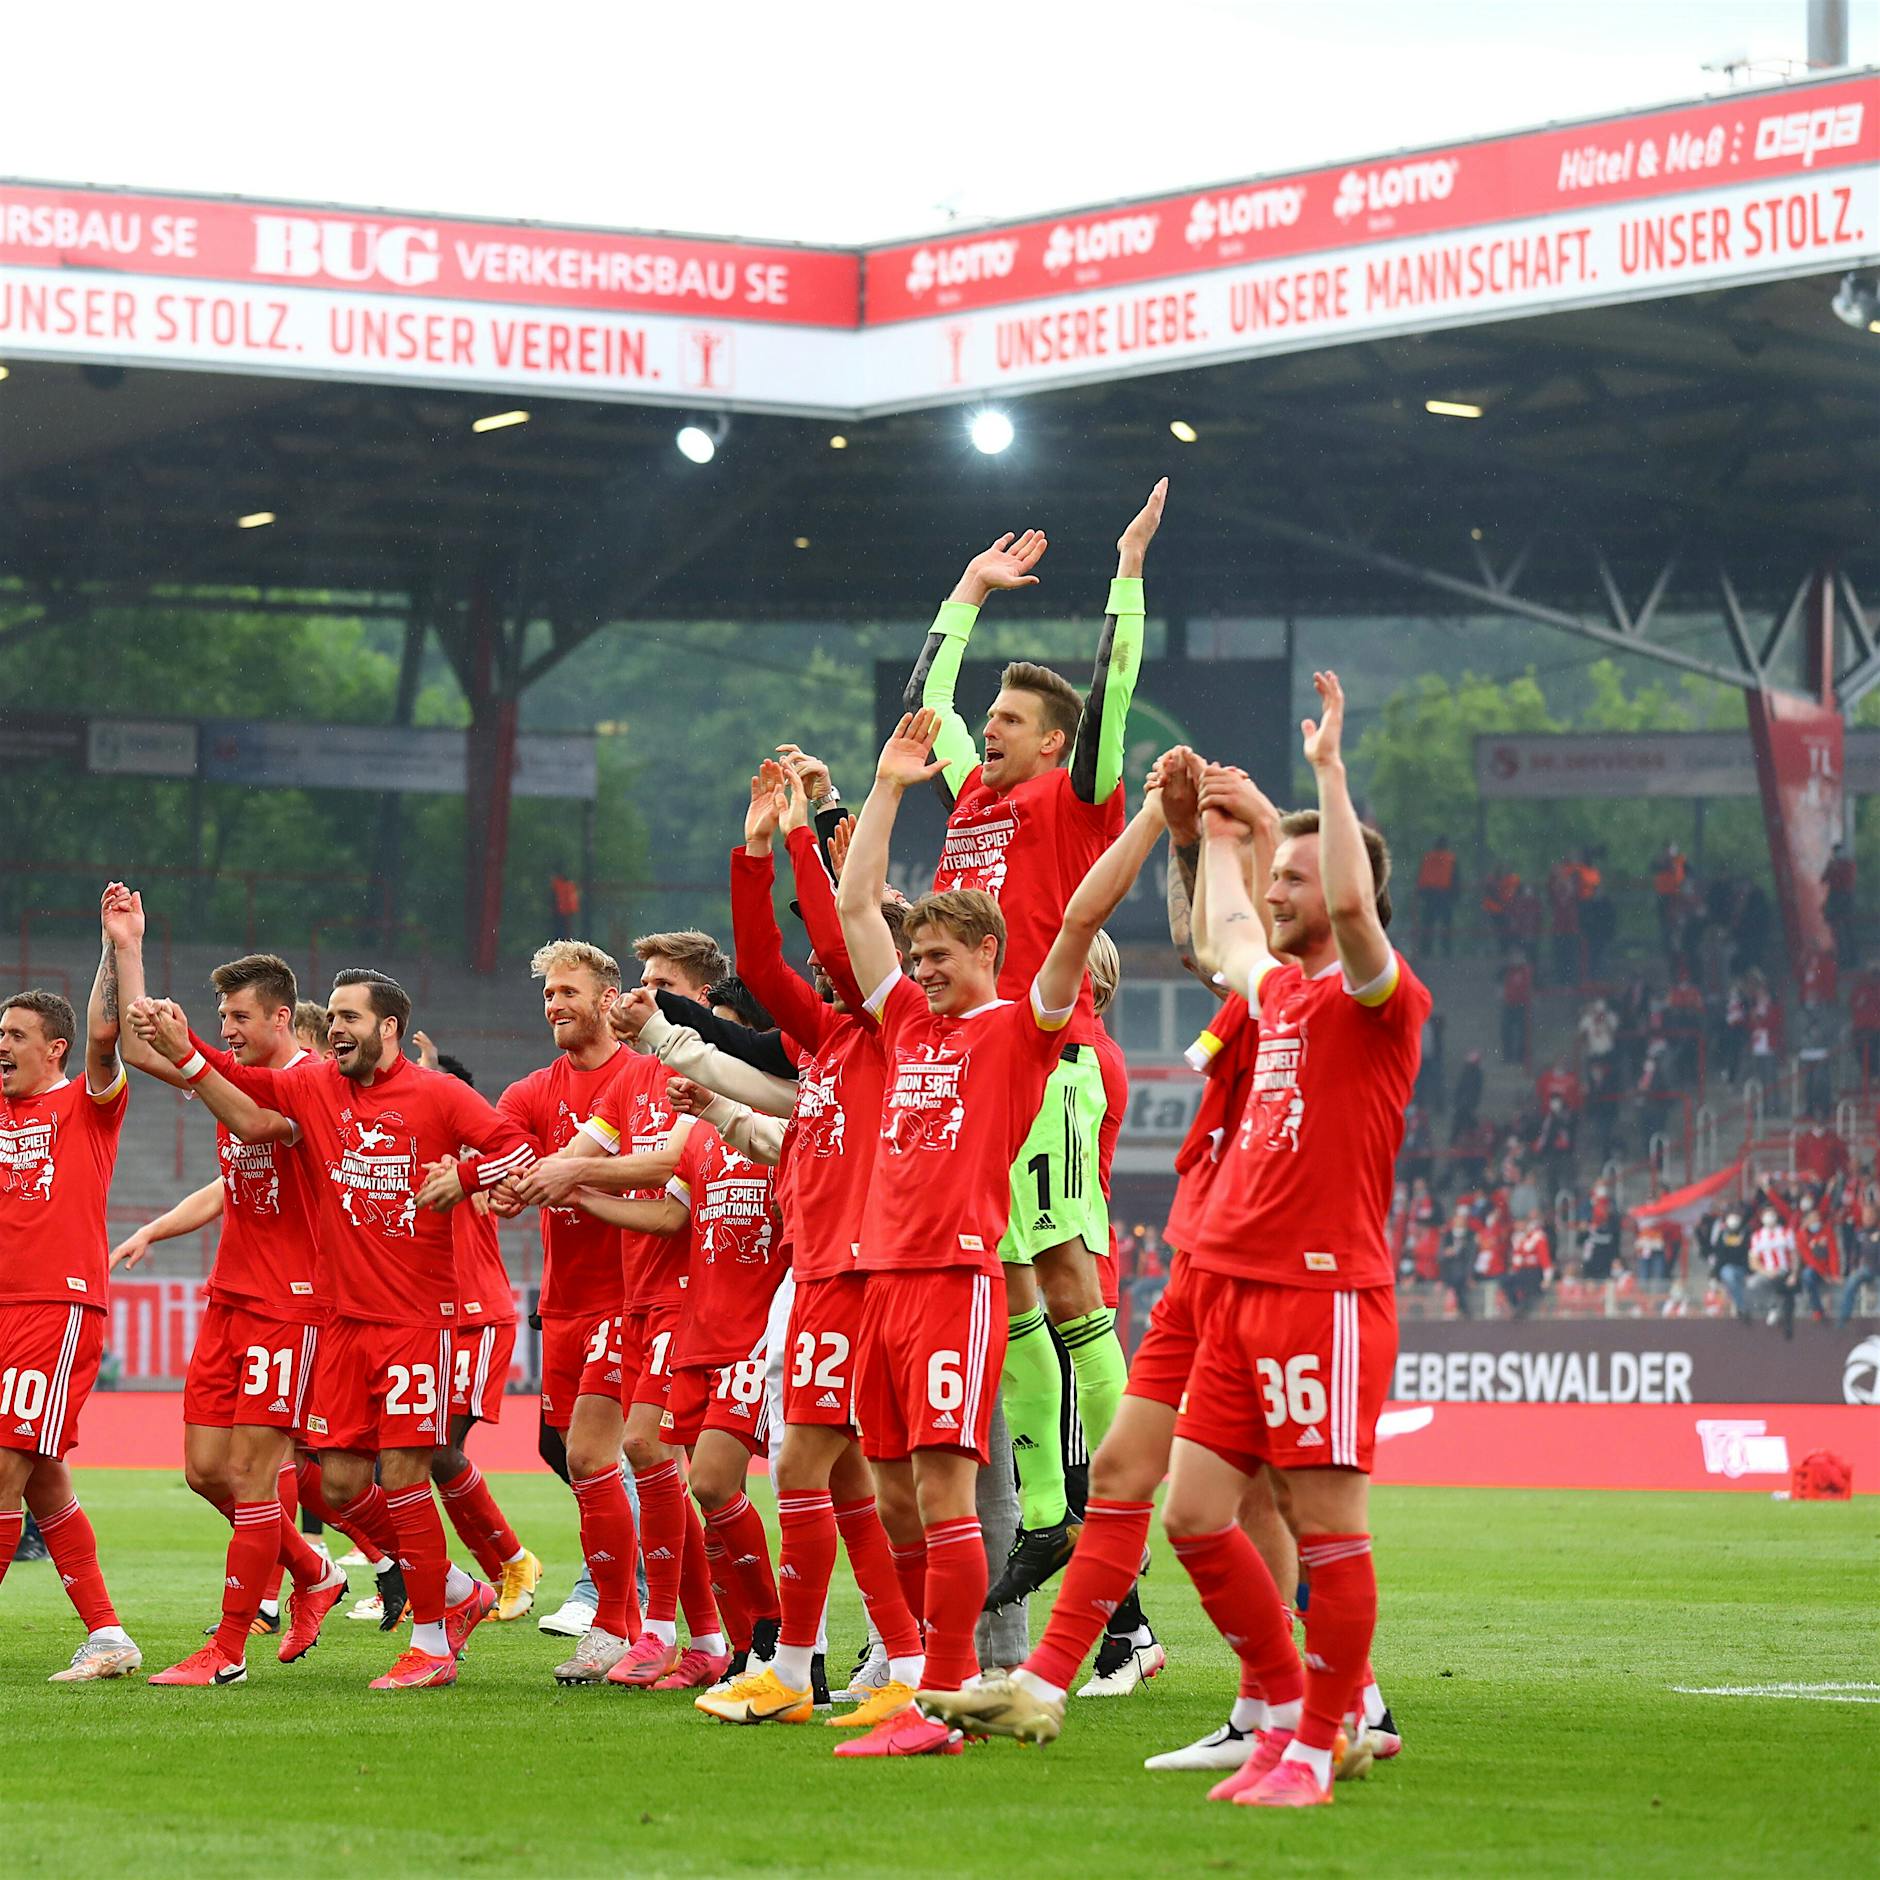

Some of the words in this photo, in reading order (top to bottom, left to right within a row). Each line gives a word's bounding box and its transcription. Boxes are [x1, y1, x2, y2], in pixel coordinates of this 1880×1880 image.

[1637, 140, 1660, 178] &
[1755, 104, 1863, 166] ospa
[0, 203, 141, 254] RSBAU
[151, 214, 198, 259] SE
[251, 215, 441, 287] BUG
[455, 240, 735, 299] VERKEHRSBAU
[746, 264, 788, 304] SE
[997, 306, 1108, 370] UNSERE
[1117, 291, 1207, 353] LIEBE.
[1229, 267, 1348, 334] UNSERE
[1366, 228, 1598, 311] MANNSCHAFT.
[1620, 207, 1731, 275] UNSER
[1744, 187, 1864, 257] STOLZ.
[155, 294, 304, 351] STOLZ.
[330, 308, 475, 365] UNSER
[491, 319, 661, 380] VEREIN.
[945, 838, 977, 854] UNION
[976, 829, 1015, 850] SPIELT
[0, 1146, 51, 1165] RNATIONAL
[19, 1133, 51, 1151] SPIELT
[240, 1142, 273, 1158] SPIELT
[341, 1157, 372, 1175] UNION
[373, 1163, 411, 1178] SPIELT
[330, 1168, 412, 1191] INTERNATIONAL
[729, 1187, 767, 1202] SPIELT
[1028, 1153, 1051, 1210] 1
[244, 1345, 293, 1397] 31
[791, 1331, 850, 1389] 32
[927, 1349, 964, 1411] 6
[1395, 1351, 1694, 1404] EBERSWALDER
[0, 1366, 48, 1420] 10
[386, 1363, 437, 1415] 23
[1256, 1353, 1328, 1428] 36
